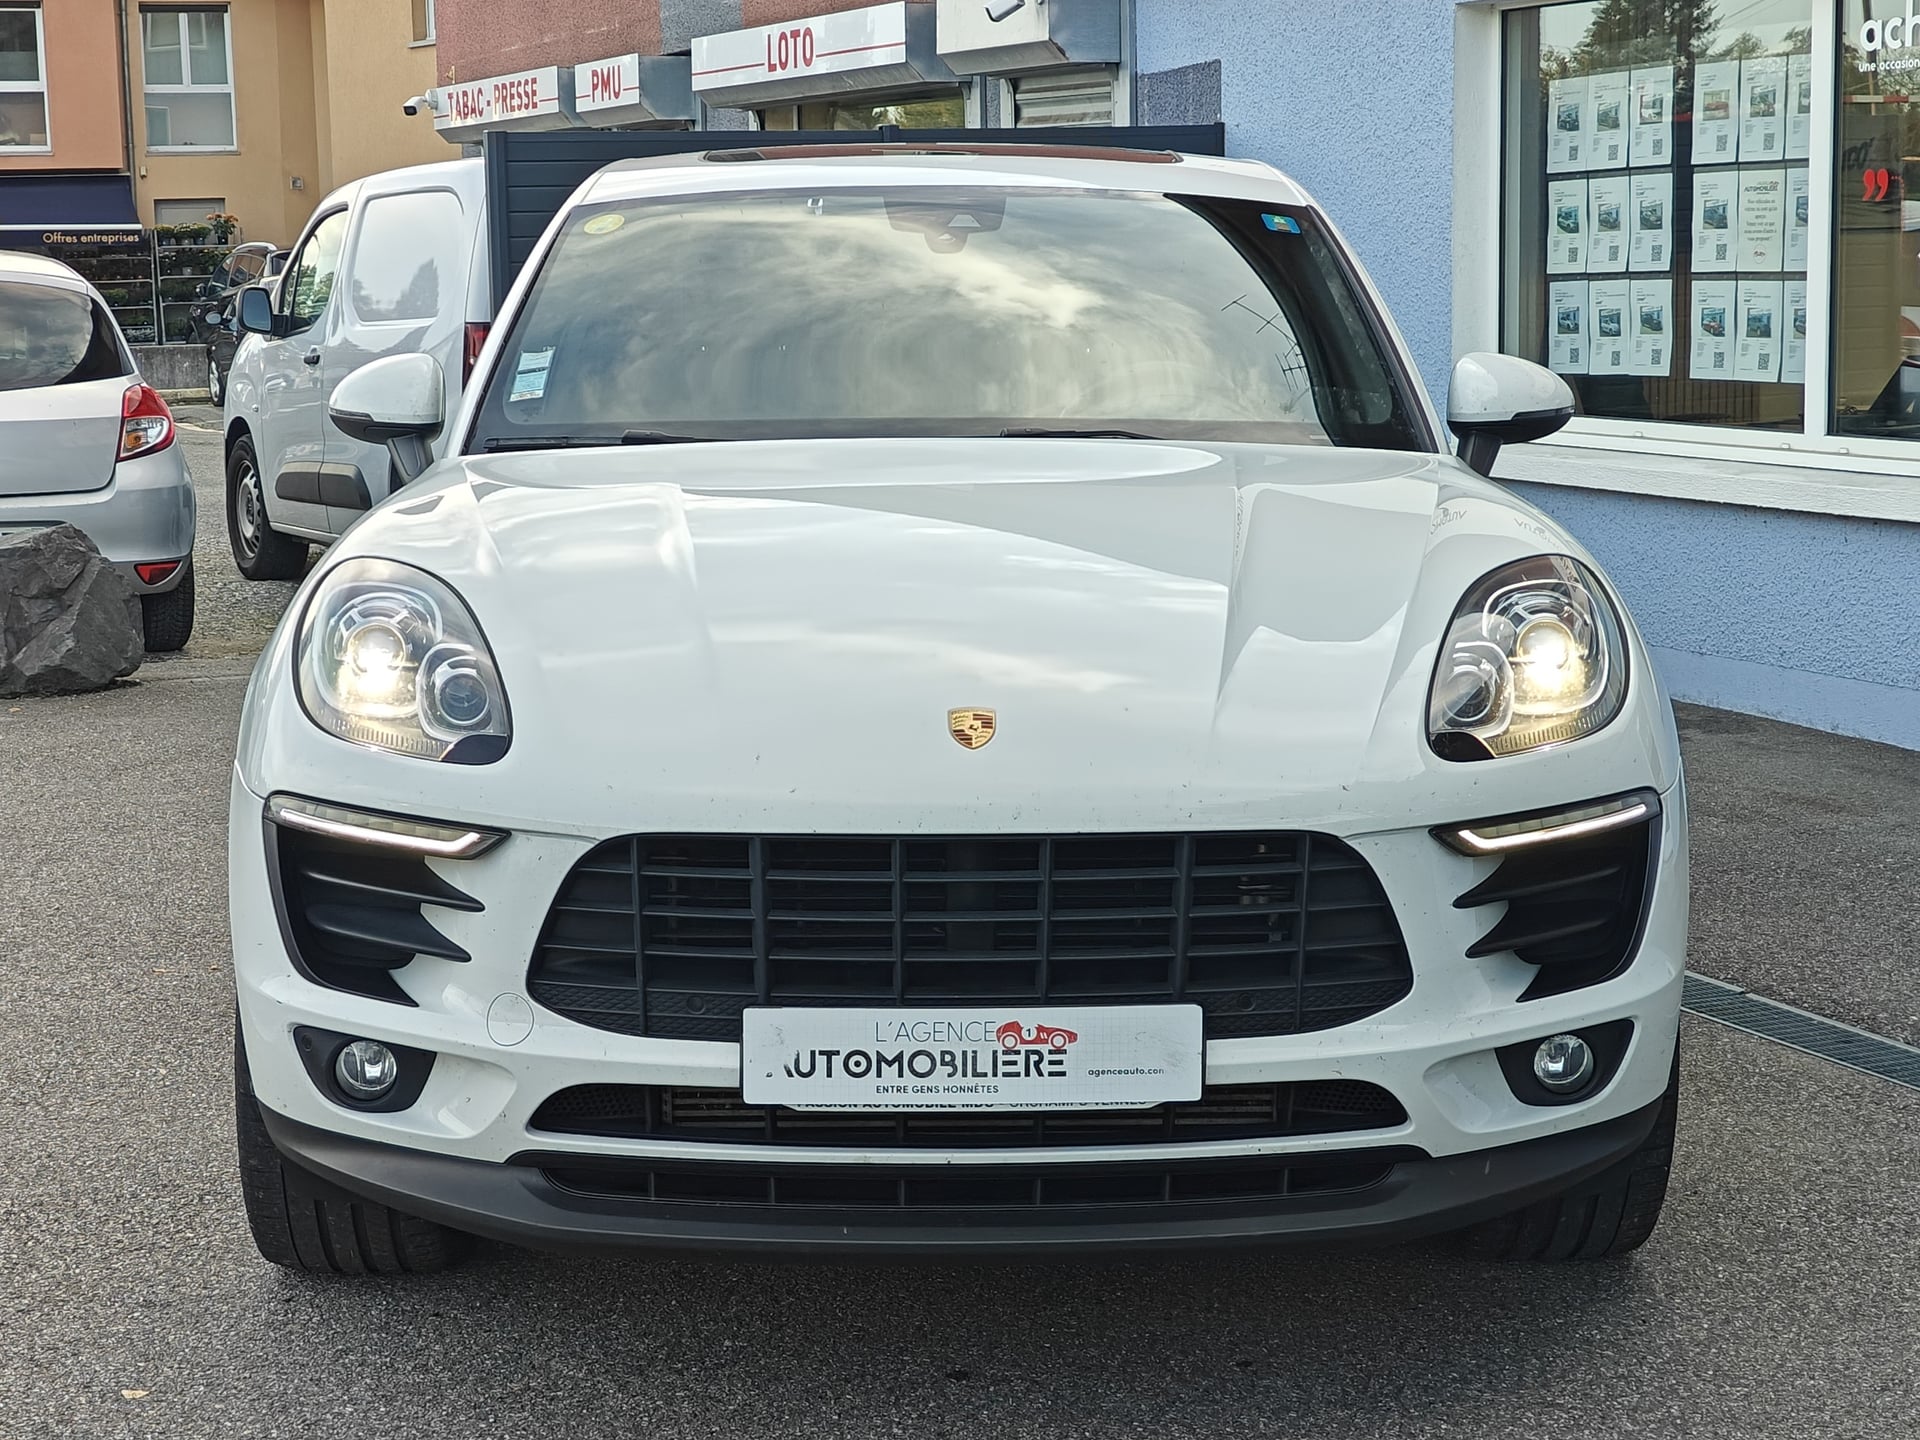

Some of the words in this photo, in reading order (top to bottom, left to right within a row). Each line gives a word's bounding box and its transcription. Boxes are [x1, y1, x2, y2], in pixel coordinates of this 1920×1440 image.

[767, 26, 814, 73] LOTO
[1858, 62, 1877, 73] une
[591, 64, 621, 103] PMU
[43, 232, 78, 243] Offres
[80, 232, 139, 245] entreprises
[875, 1020, 996, 1042] L'AGENCE
[1025, 1027, 1031, 1038] 1
[765, 1048, 1068, 1078] UTOMOBILIERE
[875, 1084, 909, 1094] ENTRE
[911, 1084, 940, 1094] GENS
[943, 1082, 1000, 1094] HONNÊTES
